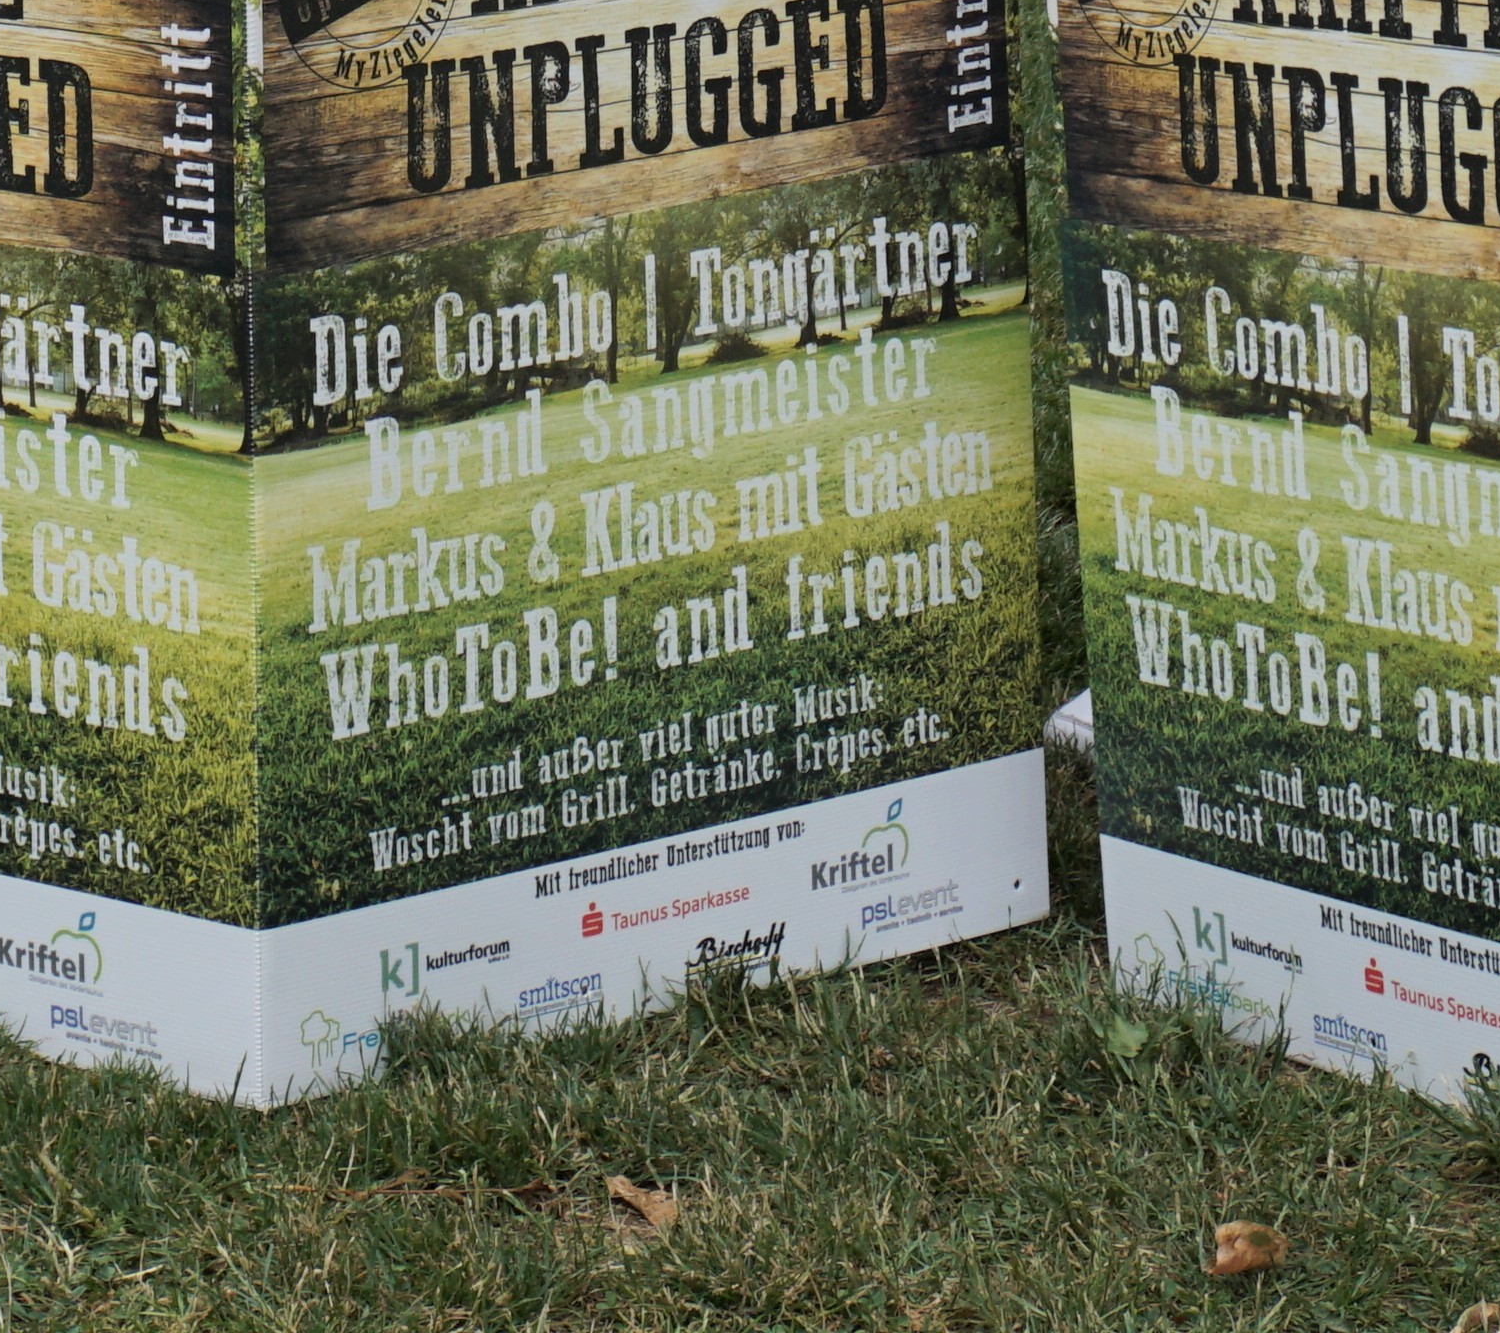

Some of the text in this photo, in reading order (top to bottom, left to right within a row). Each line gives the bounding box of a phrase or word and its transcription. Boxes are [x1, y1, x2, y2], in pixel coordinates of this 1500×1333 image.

[160, 20, 216, 253] Eintritt
[309, 214, 979, 408] Die Combo Tongärtner
[1101, 268, 1182, 370] Die
[1204, 284, 1369, 404] Combo
[1150, 381, 1312, 508] Bernd
[31, 516, 201, 640] Gästen
[320, 519, 985, 743] WhoToBe! and friends
[537, 734, 623, 786] außer
[639, 710, 692, 763] viel
[705, 700, 778, 755] guter
[535, 818, 805, 899] Mit freundlicher Unterstützung von:
[1316, 780, 1395, 835] außer
[1409, 798, 1460, 851] viel
[425, 939, 510, 973] kulturforum
[611, 888, 749, 931] Taunus Sparkasse
